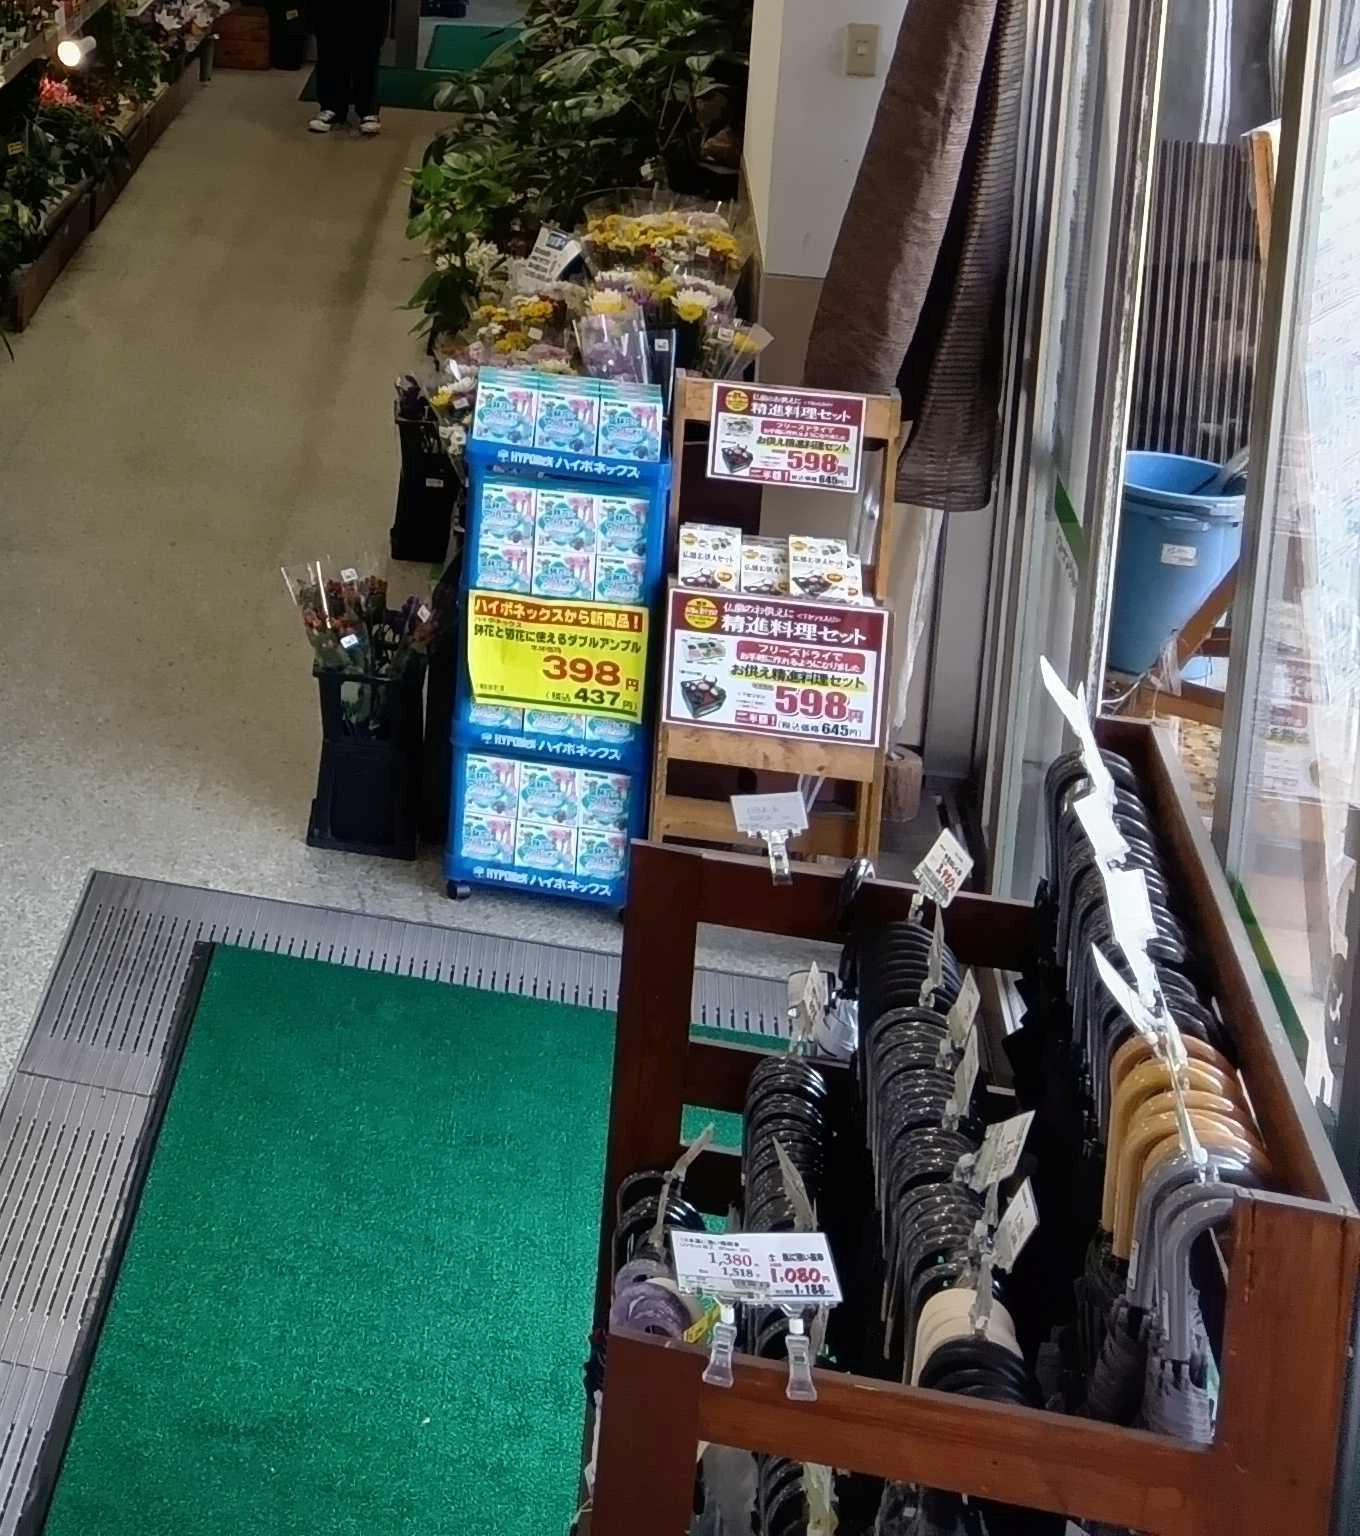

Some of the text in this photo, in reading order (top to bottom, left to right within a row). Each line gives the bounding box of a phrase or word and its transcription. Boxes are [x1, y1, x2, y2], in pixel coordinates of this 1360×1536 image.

[750, 402, 852, 423] 精進料理セット
[555, 456, 641, 479] ハイポネックス
[786, 449, 841, 475] 598
[474, 598, 640, 631] ハイポネックスから新商品！
[721, 614, 867, 646] 精進料理セット
[757, 644, 844, 662] フリーズドライで
[541, 654, 640, 692] 398 円
[730, 664, 866, 689] お供え精進料理セット
[573, 687, 621, 707] 437
[774, 686, 850, 722] 598
[821, 722, 849, 737] 645
[538, 739, 622, 762] ハイポネックス
[529, 873, 614, 897] ハイポネックス
[708, 1251, 753, 1267] 1,380
[722, 1267, 754, 1279] 1,518
[770, 1268, 823, 1284] 1,080
